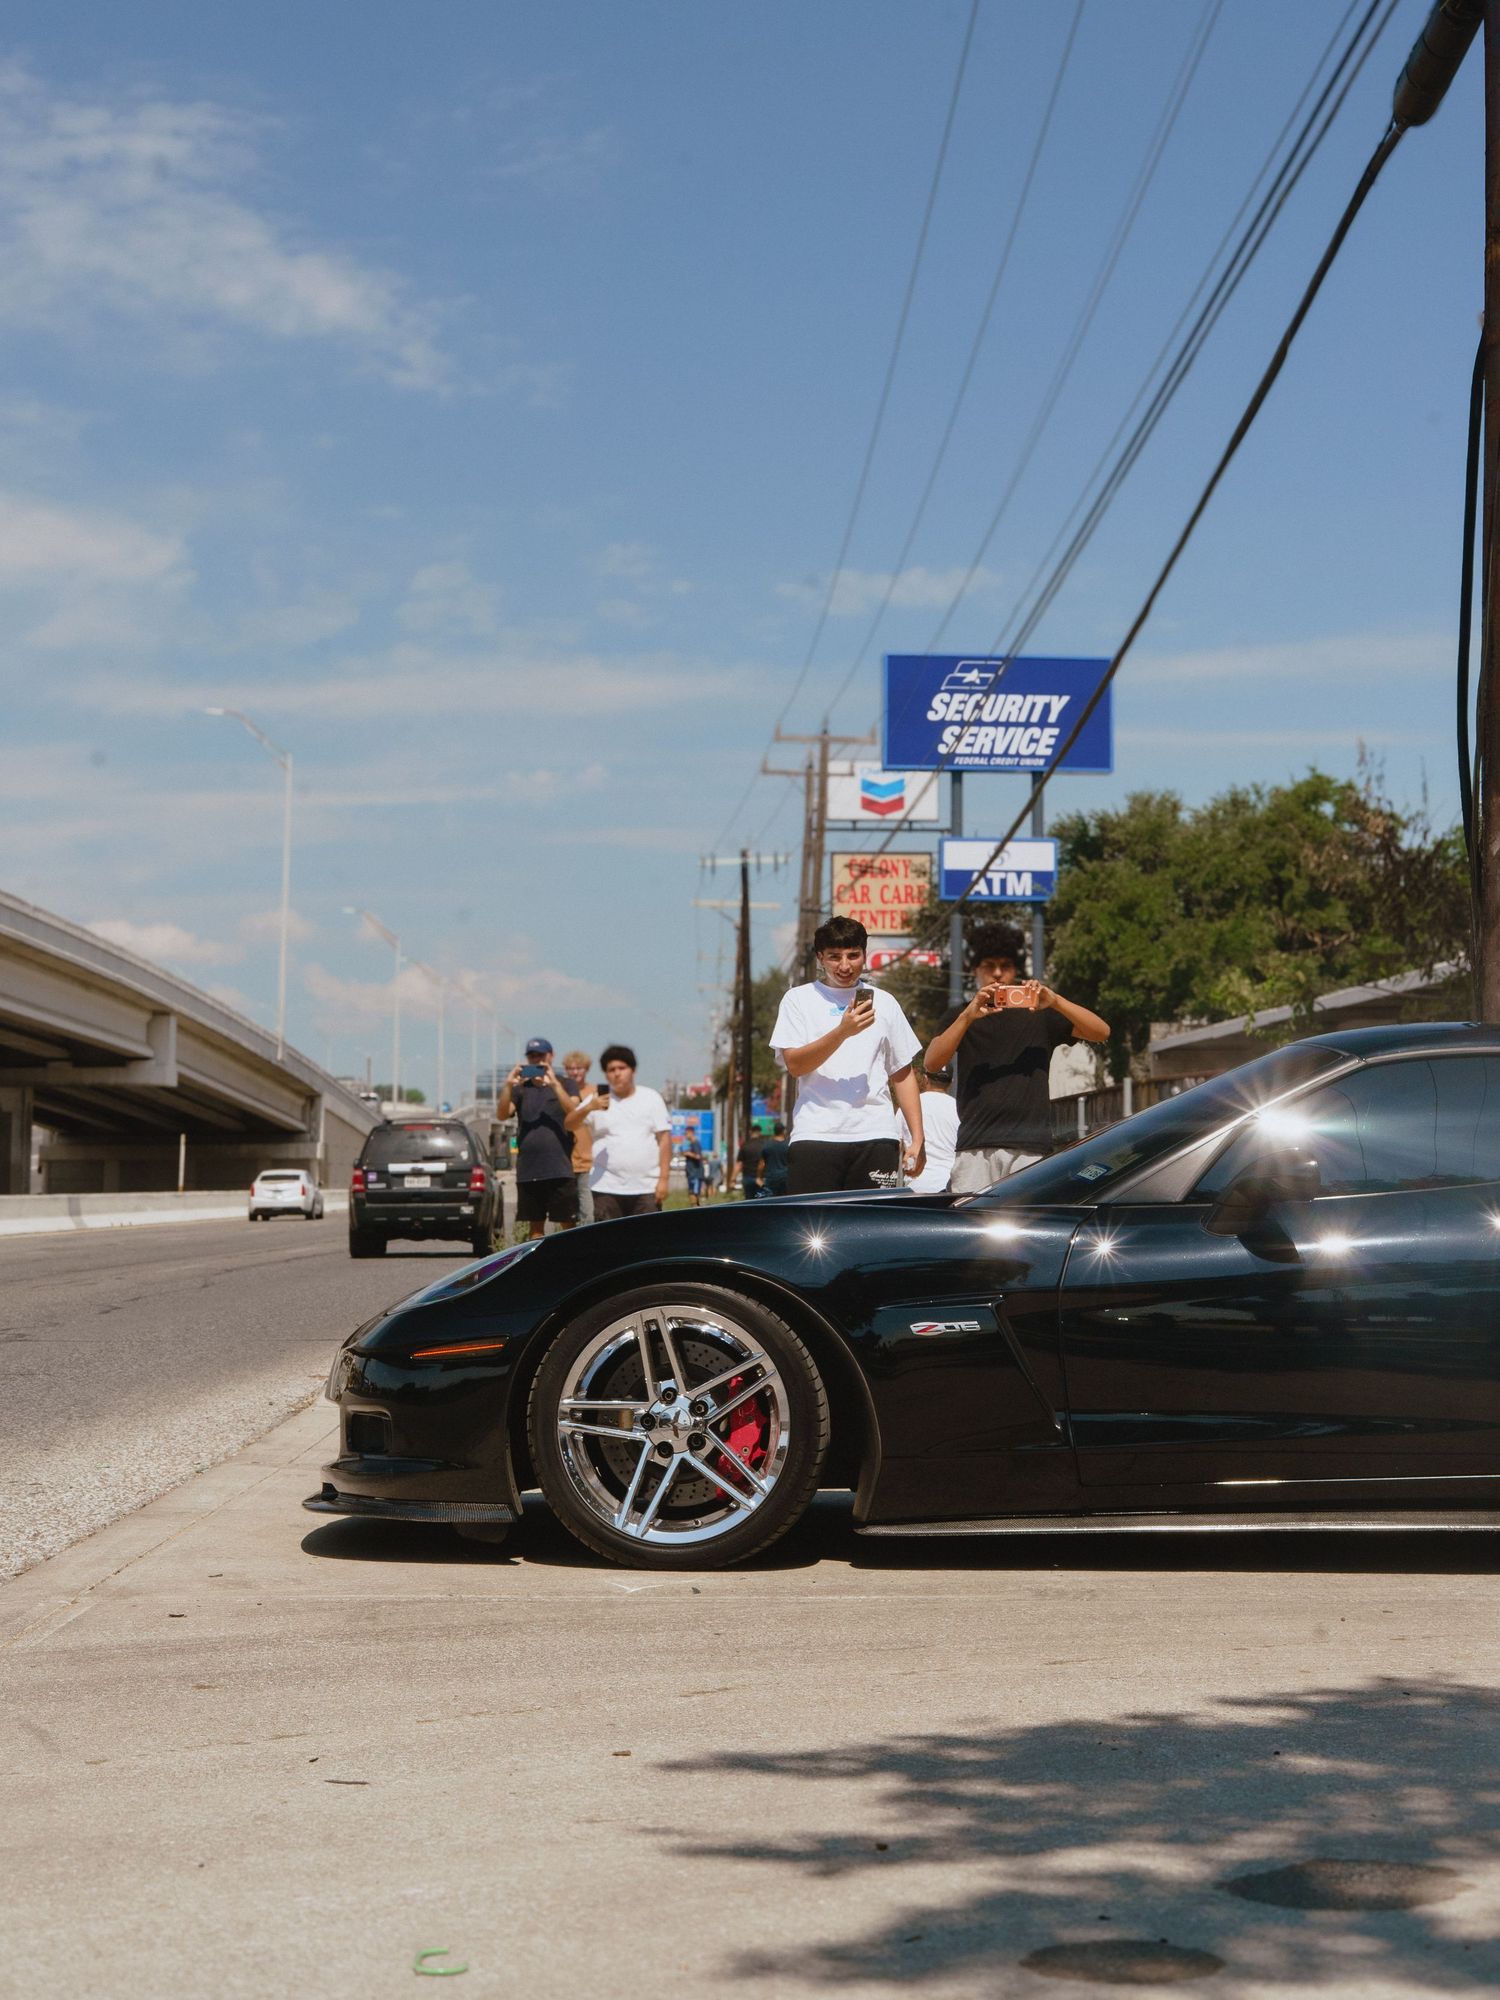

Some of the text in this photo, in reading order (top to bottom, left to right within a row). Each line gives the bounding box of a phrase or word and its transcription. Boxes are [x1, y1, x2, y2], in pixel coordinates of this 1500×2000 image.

[927, 692, 1071, 723] SECURITY
[938, 725, 1060, 756] SERVICE
[953, 756, 1045, 766] FEDERAL CREDIT UNION
[848, 858, 912, 879] COLONY
[836, 884, 929, 904] CAR CARE
[969, 871, 1032, 896] ATM
[910, 1321, 981, 1336] Z06
